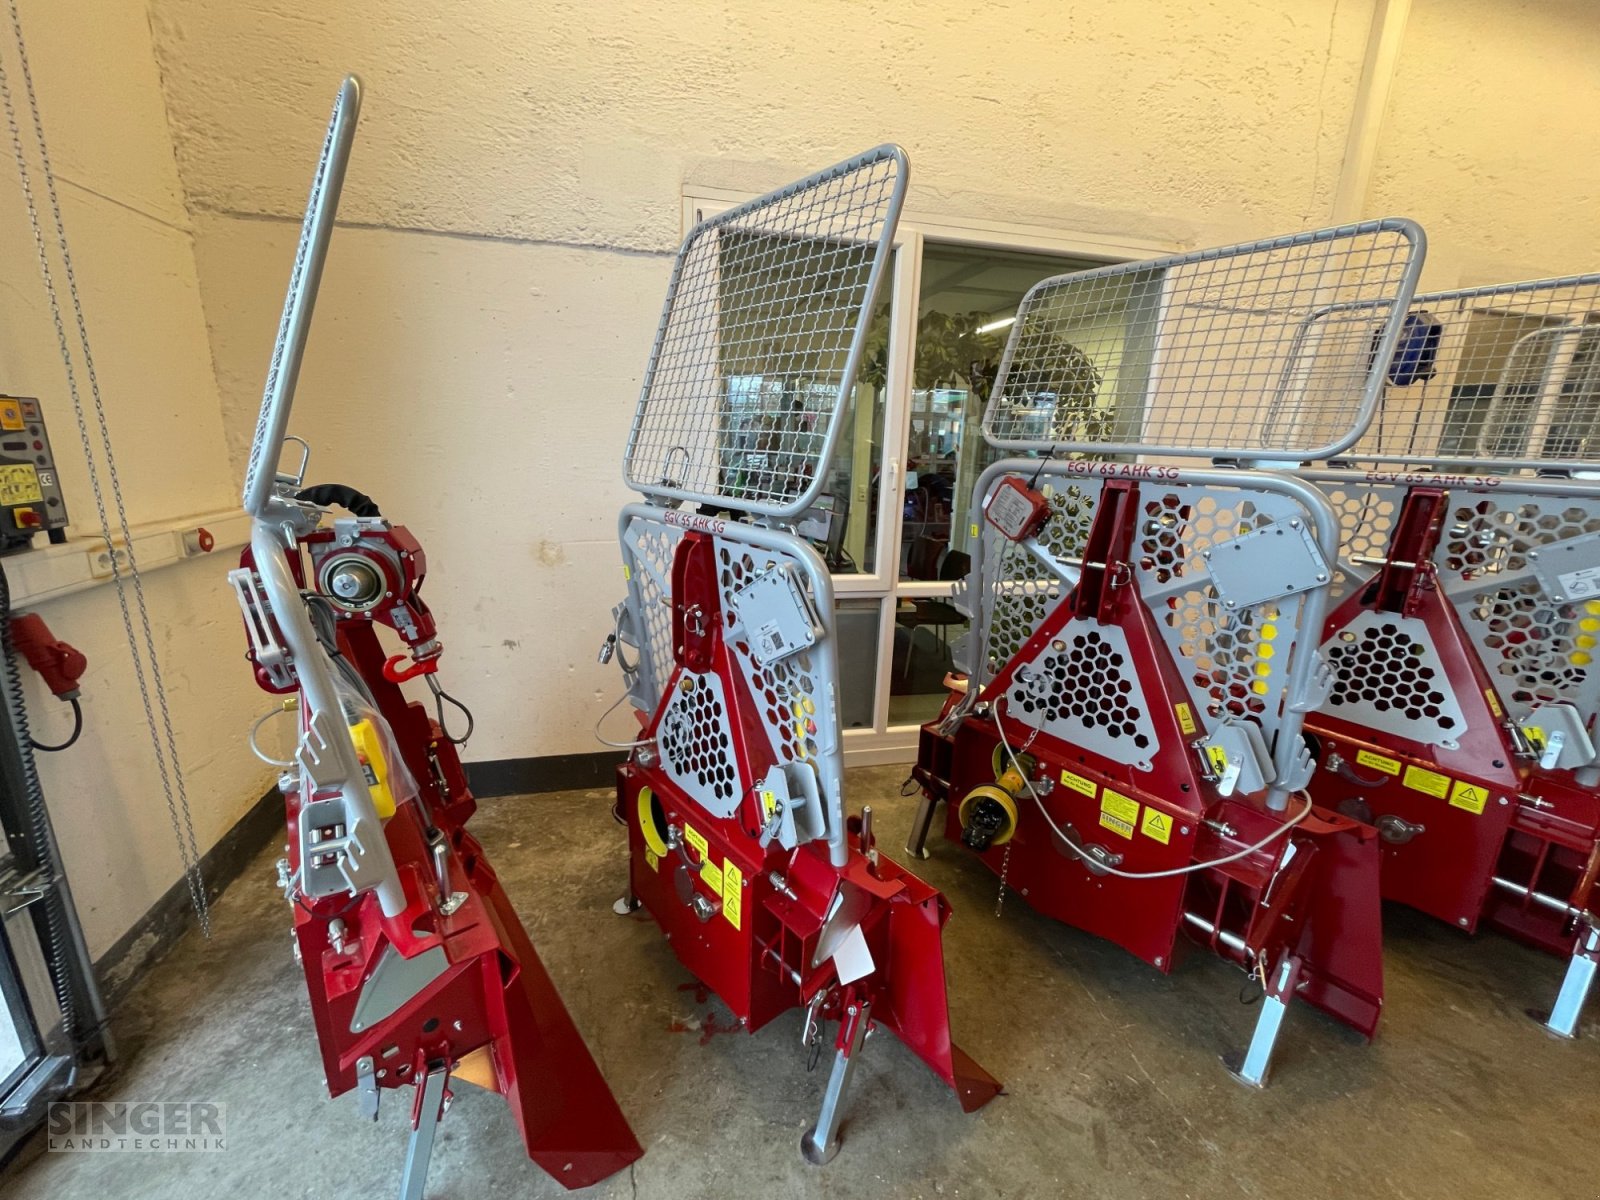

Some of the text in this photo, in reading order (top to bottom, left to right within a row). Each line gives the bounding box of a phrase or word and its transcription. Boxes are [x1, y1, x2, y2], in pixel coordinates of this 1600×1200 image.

[1067, 461, 1180, 479] EGV 65 AHK SG
[1365, 470, 1502, 487] EGV 65 AHK SG
[664, 511, 726, 534] EGV 55 AHK SG
